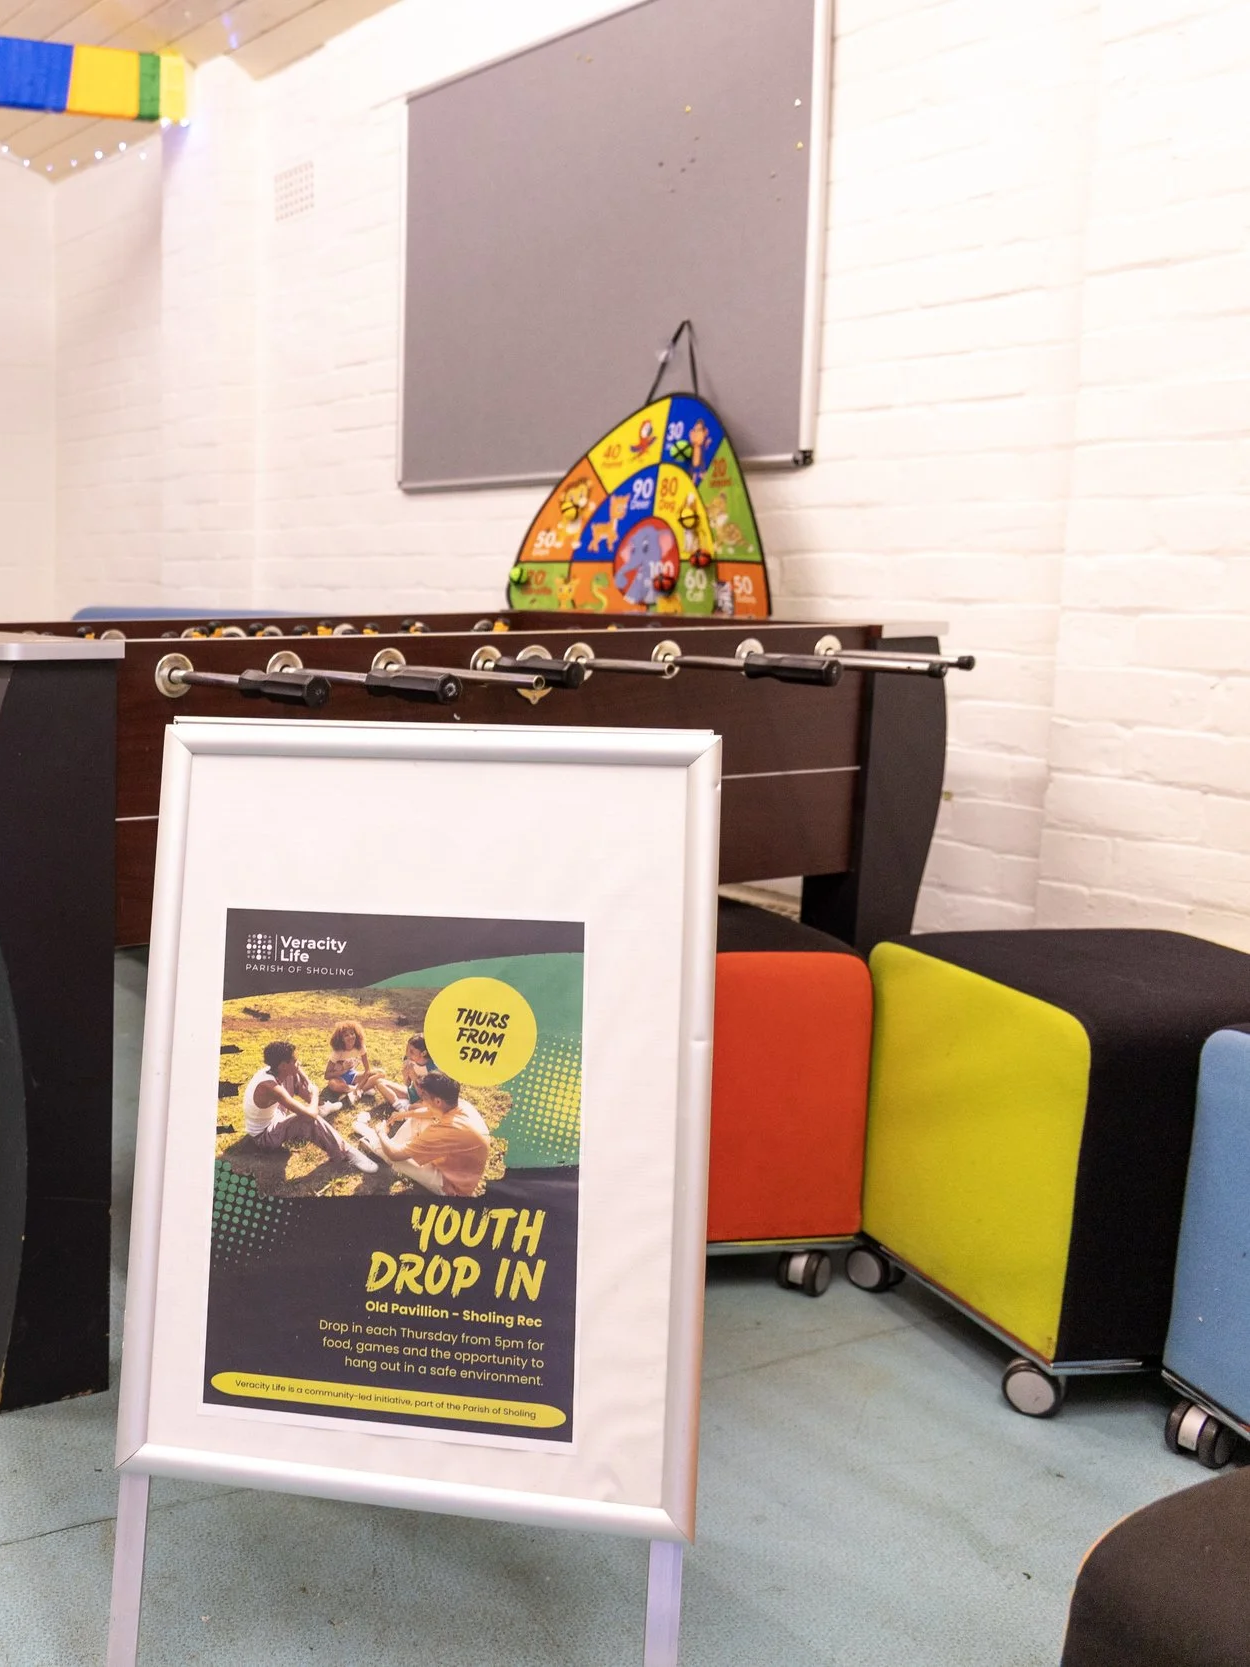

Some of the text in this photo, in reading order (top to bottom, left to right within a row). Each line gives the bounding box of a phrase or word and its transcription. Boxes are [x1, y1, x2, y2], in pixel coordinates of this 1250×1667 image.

[667, 421, 685, 441] 30
[603, 444, 621, 460] 40
[632, 476, 654, 500] 90
[659, 477, 678, 497] 80
[684, 568, 707, 590] 60
[733, 575, 753, 595] 50
[280, 935, 347, 954] Veracity
[280, 948, 310, 963] Life
[245, 963, 355, 976] PARISH OF SHOLING
[456, 1007, 510, 1030] THURS
[456, 1027, 505, 1048] FROM
[458, 1046, 498, 1066] 5PM
[411, 1204, 546, 1257] YOUTH
[365, 1251, 547, 1301] DROP IN
[365, 1300, 388, 1313] Old
[391, 1303, 449, 1319] Pavillion
[463, 1309, 514, 1328] Sholing
[517, 1314, 543, 1328] Rec
[319, 1319, 545, 1351] Drop in each Thursday from 5pm for
[323, 1336, 545, 1370] food, games and the opportunity to
[344, 1355, 544, 1387] hang out in a safe environment.
[235, 1379, 270, 1392] Veracity
[271, 1383, 286, 1392] Life
[288, 1385, 295, 1393] is
[304, 1388, 372, 1401] community-led
[374, 1394, 413, 1407] initiative,
[414, 1400, 434, 1410] part
[435, 1401, 445, 1409] of
[446, 1402, 461, 1411] the
[463, 1404, 490, 1414] Parish
[492, 1407, 502, 1415] of
[503, 1407, 537, 1421] Sholing
